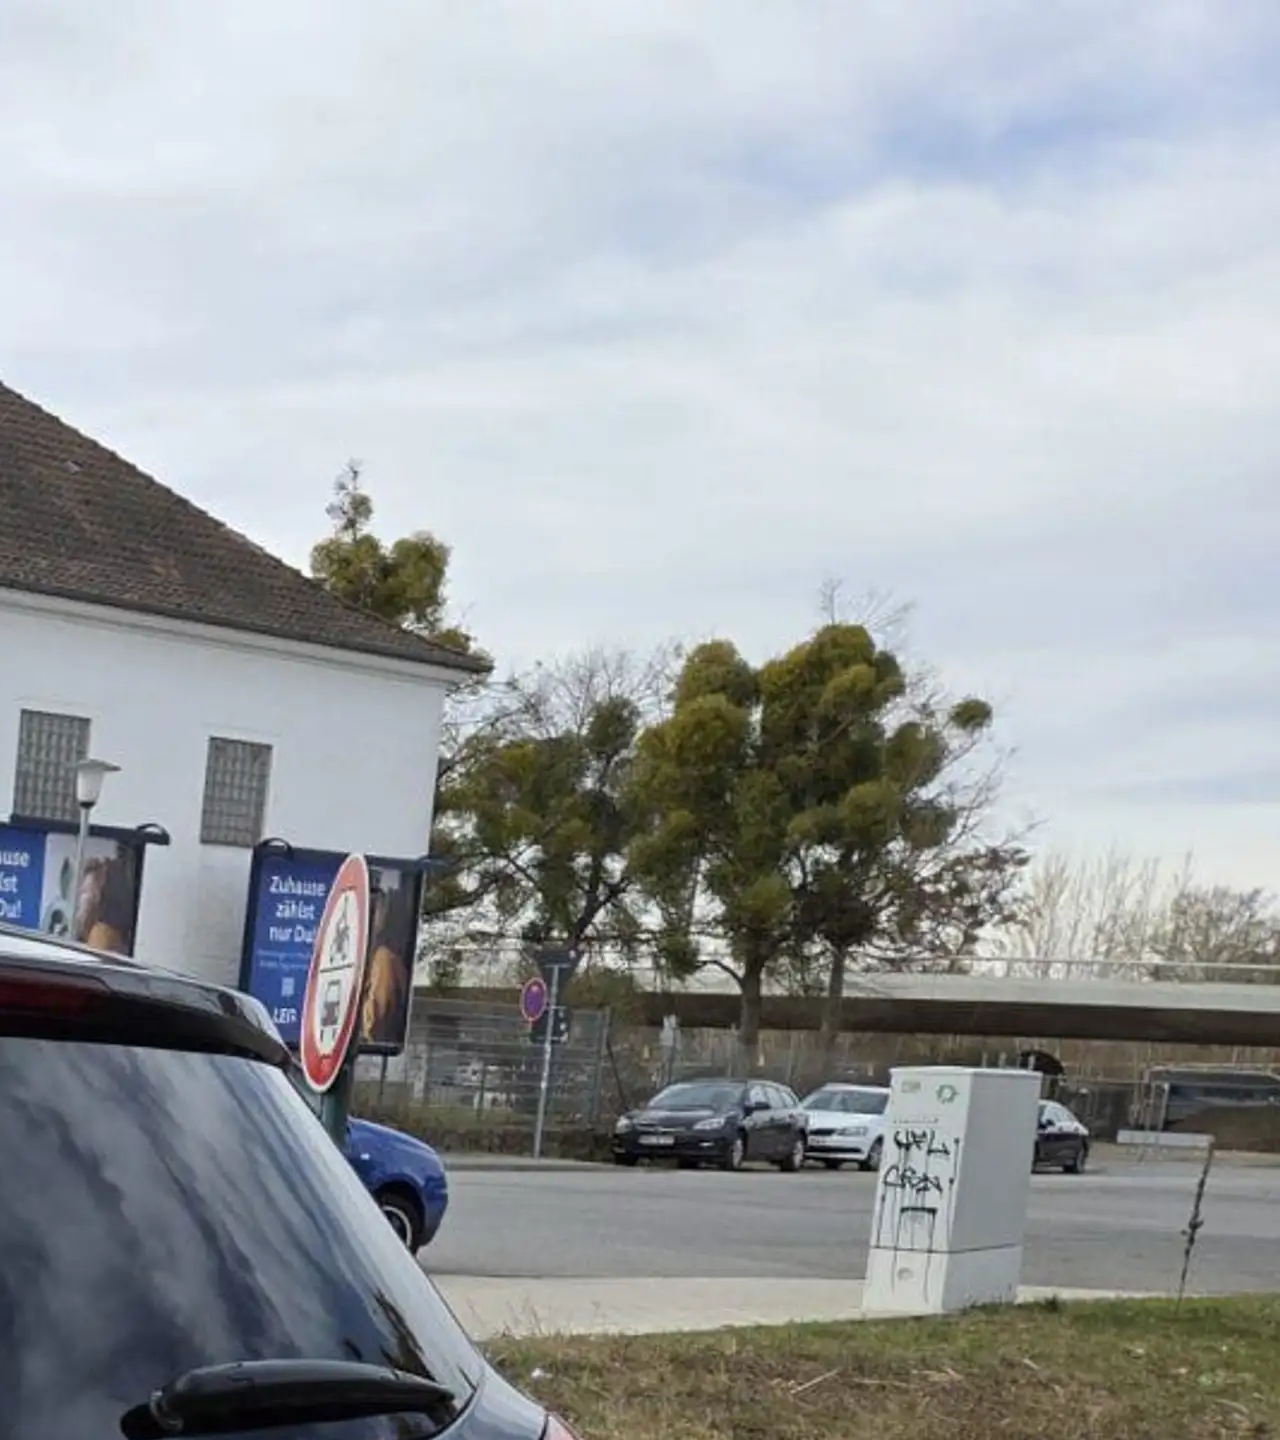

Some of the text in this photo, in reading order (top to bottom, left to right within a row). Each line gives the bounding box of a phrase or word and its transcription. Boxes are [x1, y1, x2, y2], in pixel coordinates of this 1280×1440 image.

[269, 875, 326, 897] Zuhause
[275, 899, 315, 921] zählst
[269, 926, 292, 942] nur
